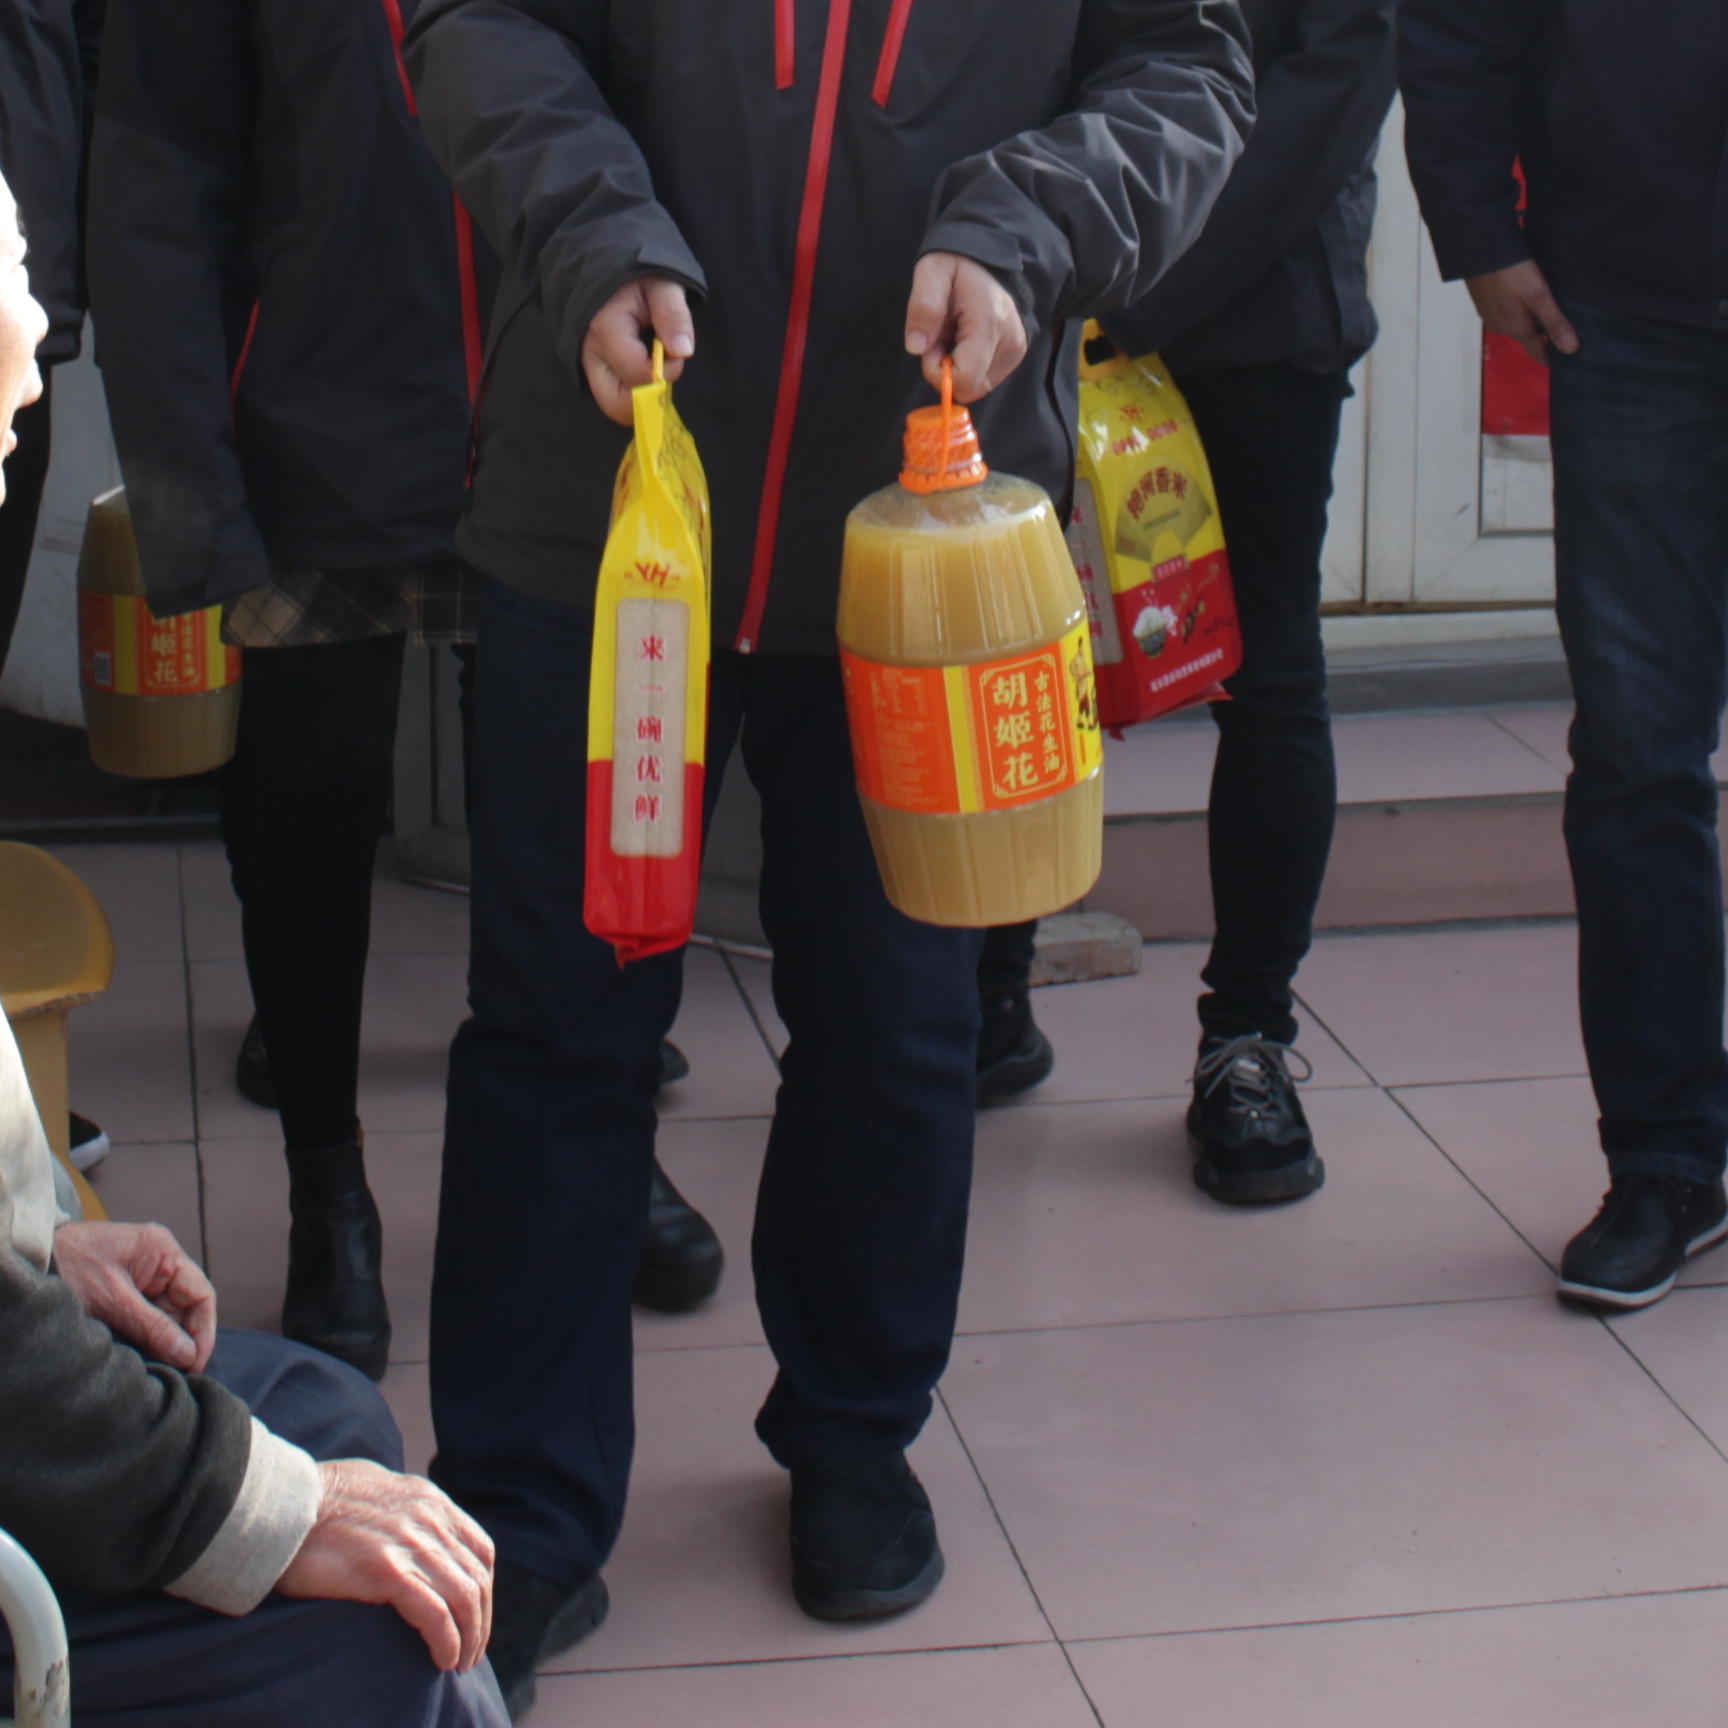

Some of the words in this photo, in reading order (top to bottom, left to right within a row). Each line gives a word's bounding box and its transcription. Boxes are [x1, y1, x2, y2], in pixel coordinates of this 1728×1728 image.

[633, 634, 666, 823] 来一碗优鲜
[991, 670, 1040, 791] 胡姬花
[1033, 670, 1061, 774] 古法花生油
